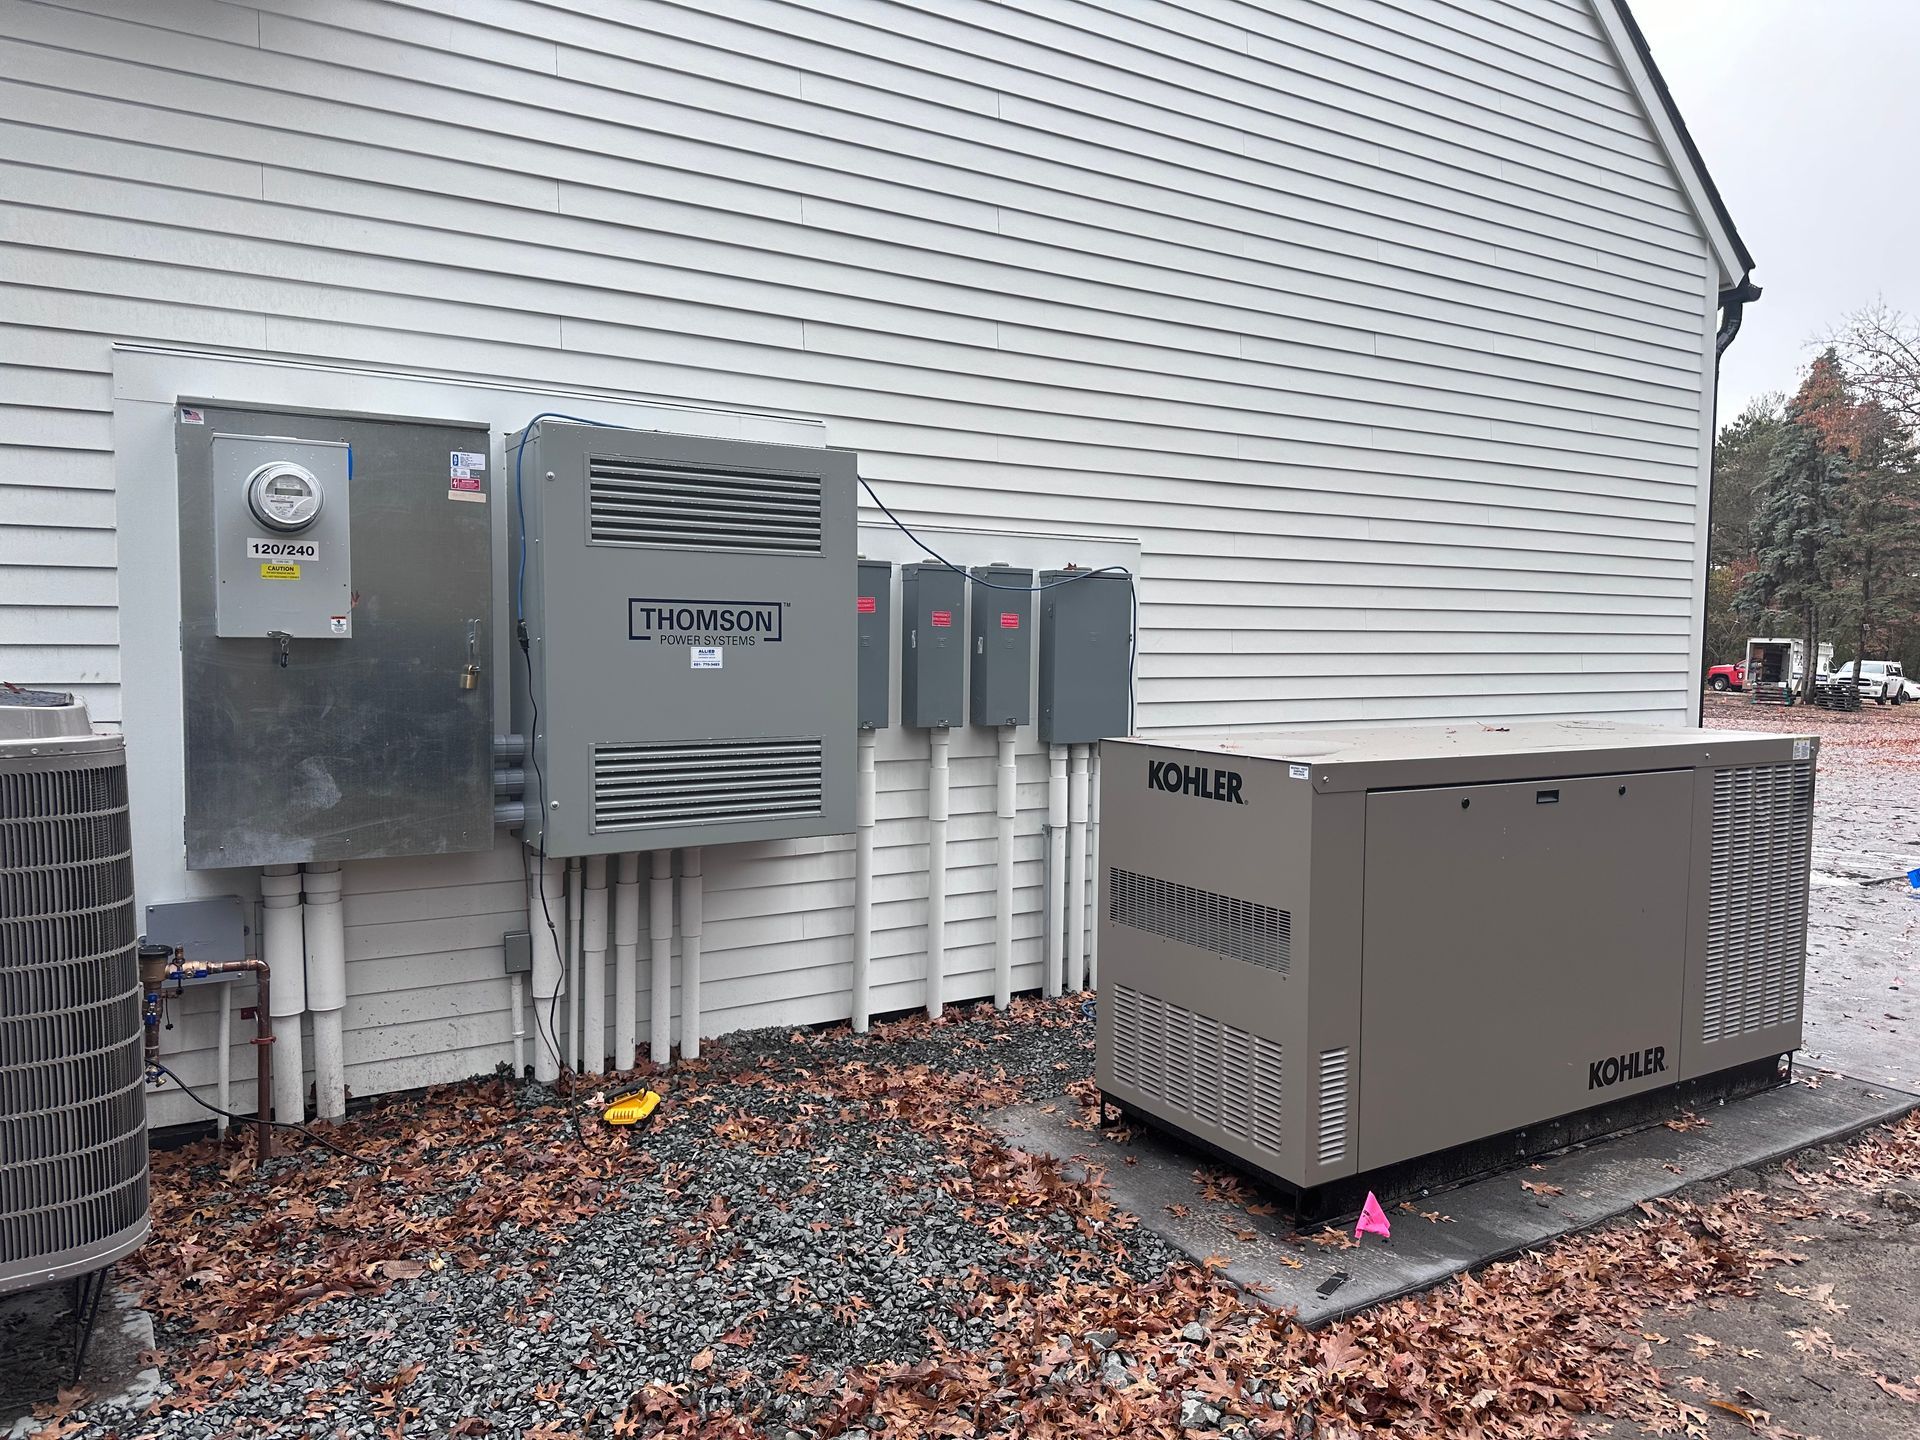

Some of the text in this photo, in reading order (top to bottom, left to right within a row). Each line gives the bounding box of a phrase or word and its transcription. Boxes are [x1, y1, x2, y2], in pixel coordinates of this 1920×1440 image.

[252, 543, 315, 556] 120/240
[640, 608, 772, 632] THOMSON
[660, 634, 756, 646] POWER SYSTEMS
[1148, 760, 1243, 805] KOHLER
[1588, 1046, 1666, 1090] KOHLER
